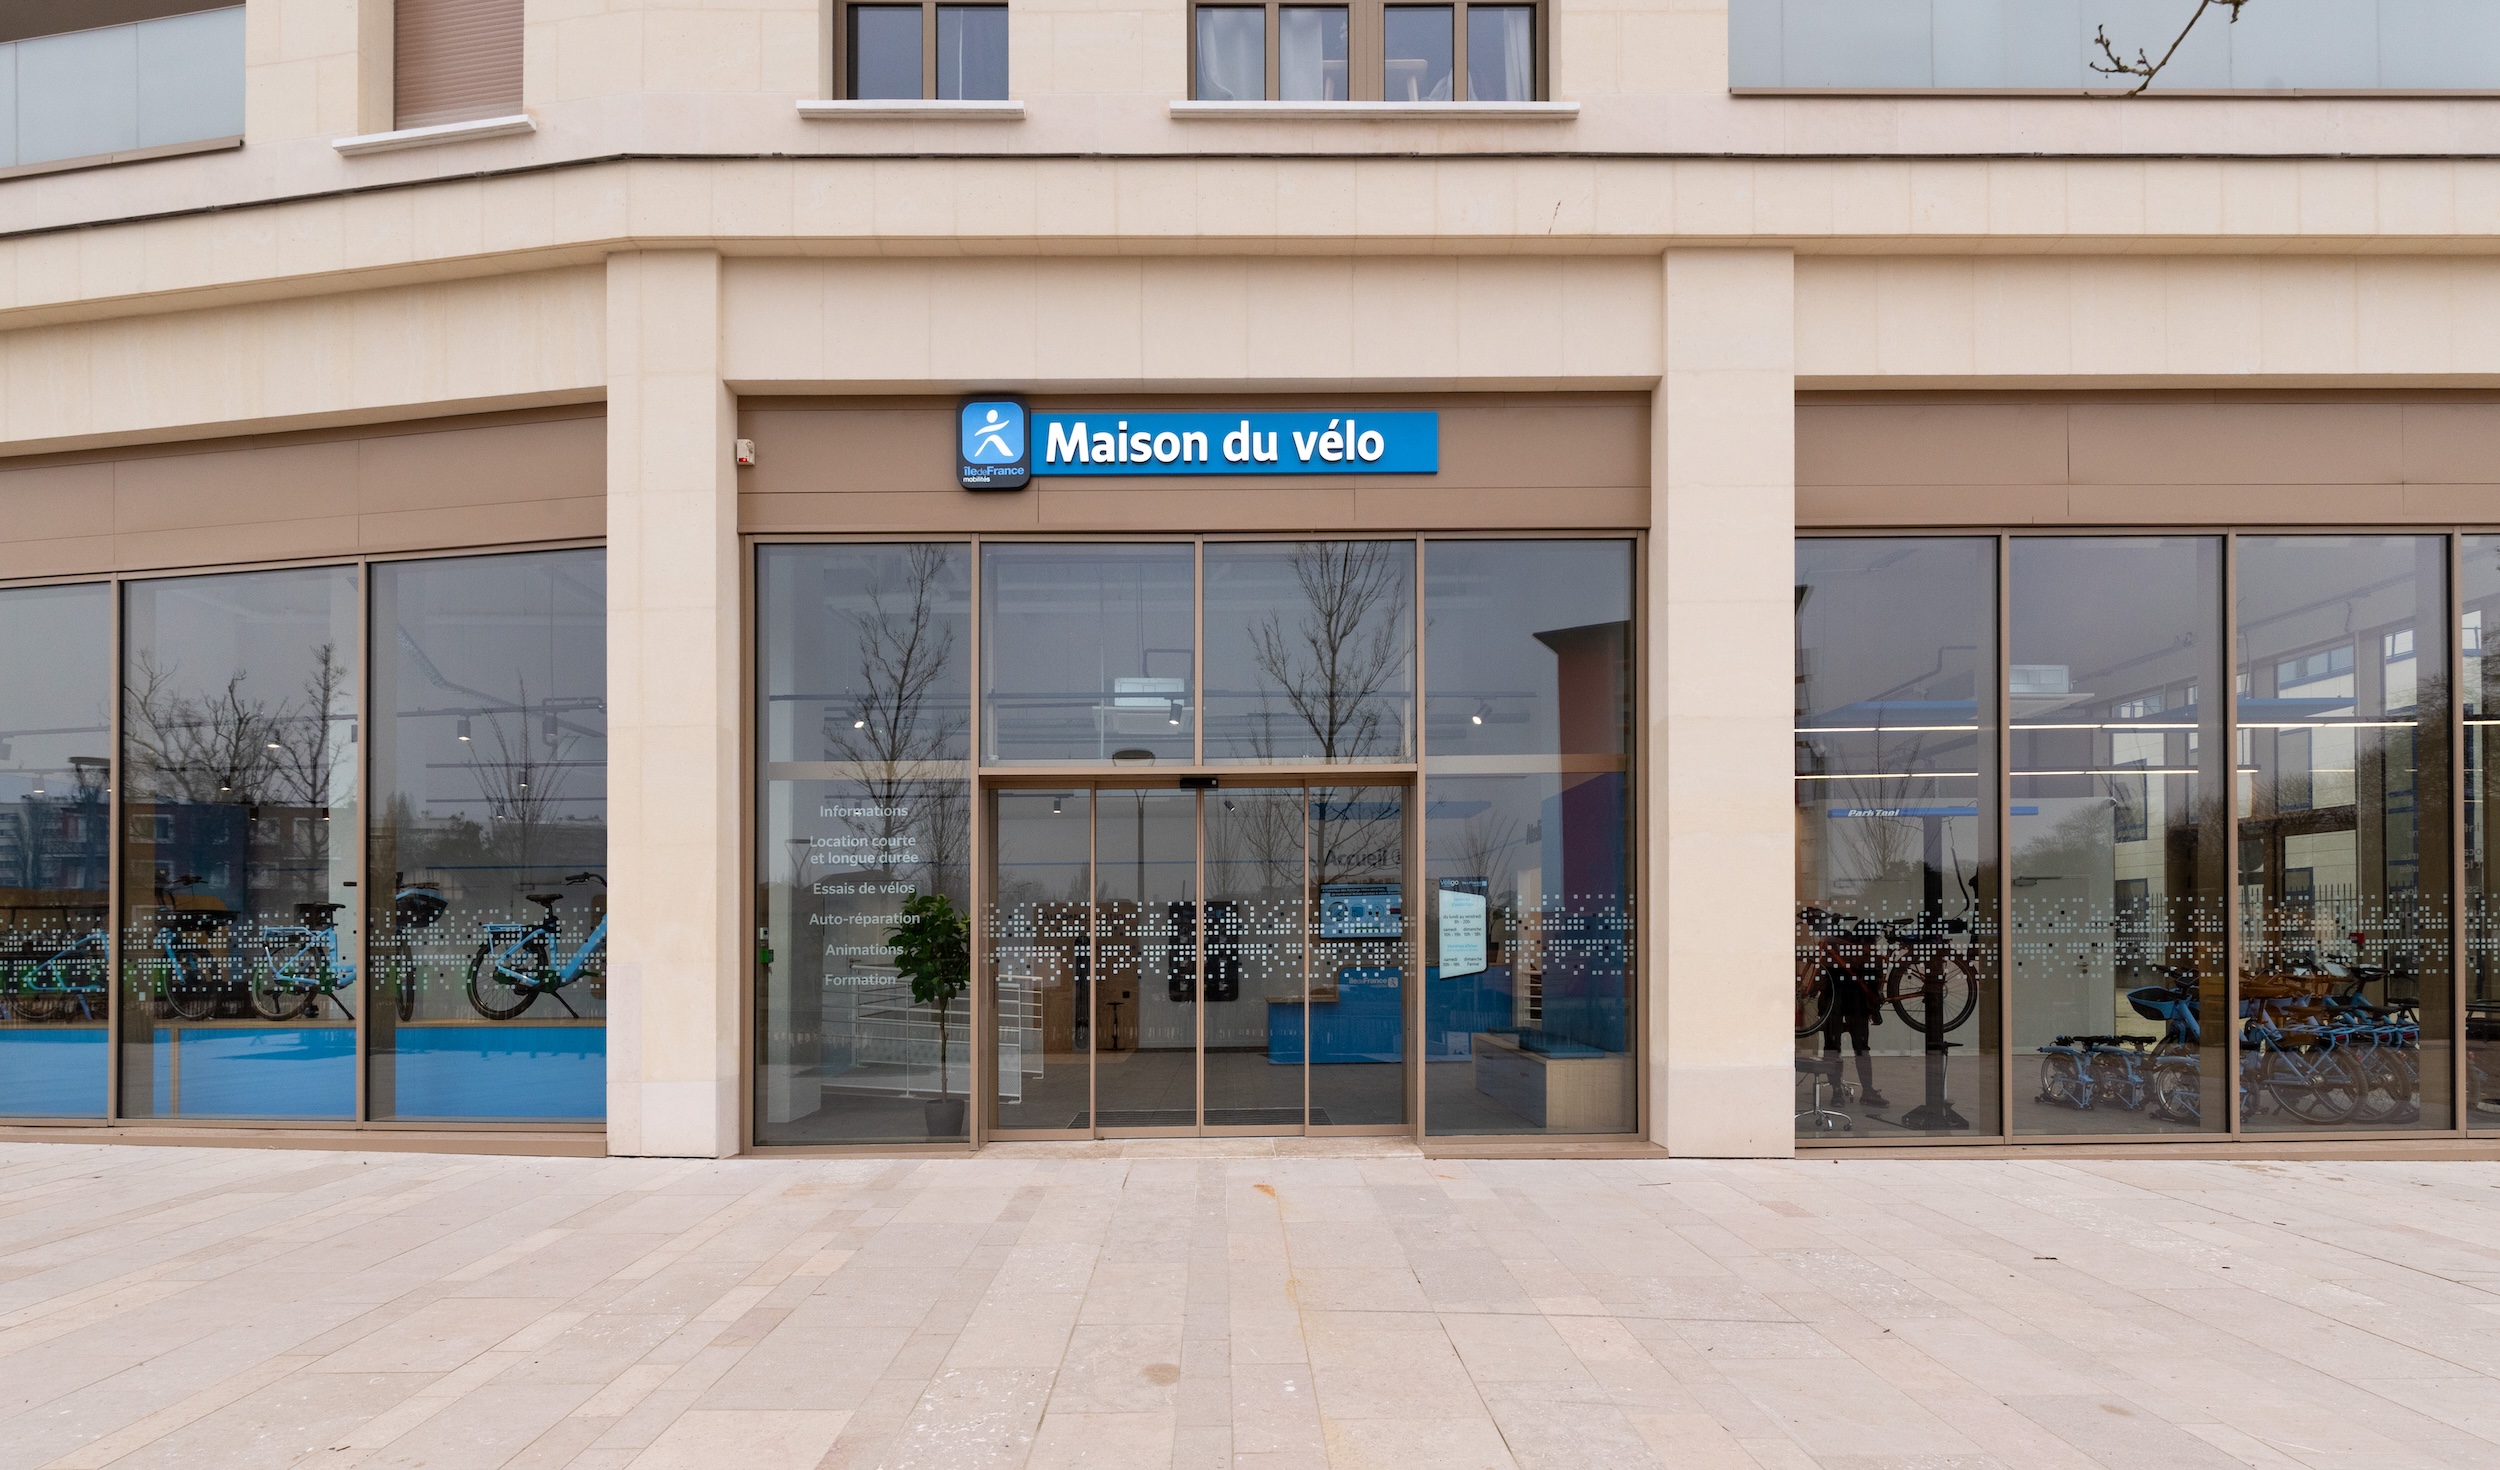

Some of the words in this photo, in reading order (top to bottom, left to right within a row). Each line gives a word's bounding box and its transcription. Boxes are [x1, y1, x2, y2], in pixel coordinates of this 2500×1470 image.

[1045, 421, 1208, 464] Maison
[1222, 420, 1277, 462] du
[1292, 418, 1385, 462] vélo
[820, 806, 908, 817] Informations
[810, 836, 868, 847] Location
[872, 837, 916, 847] courte
[810, 854, 824, 864] et
[828, 852, 875, 867] longue
[879, 852, 918, 863] durée
[814, 883, 854, 894] Essais
[859, 883, 875, 894] de
[880, 882, 915, 894] vélos
[809, 913, 920, 927] Auto-réparation
[826, 944, 904, 956] Animations
[825, 974, 896, 986] Formation
